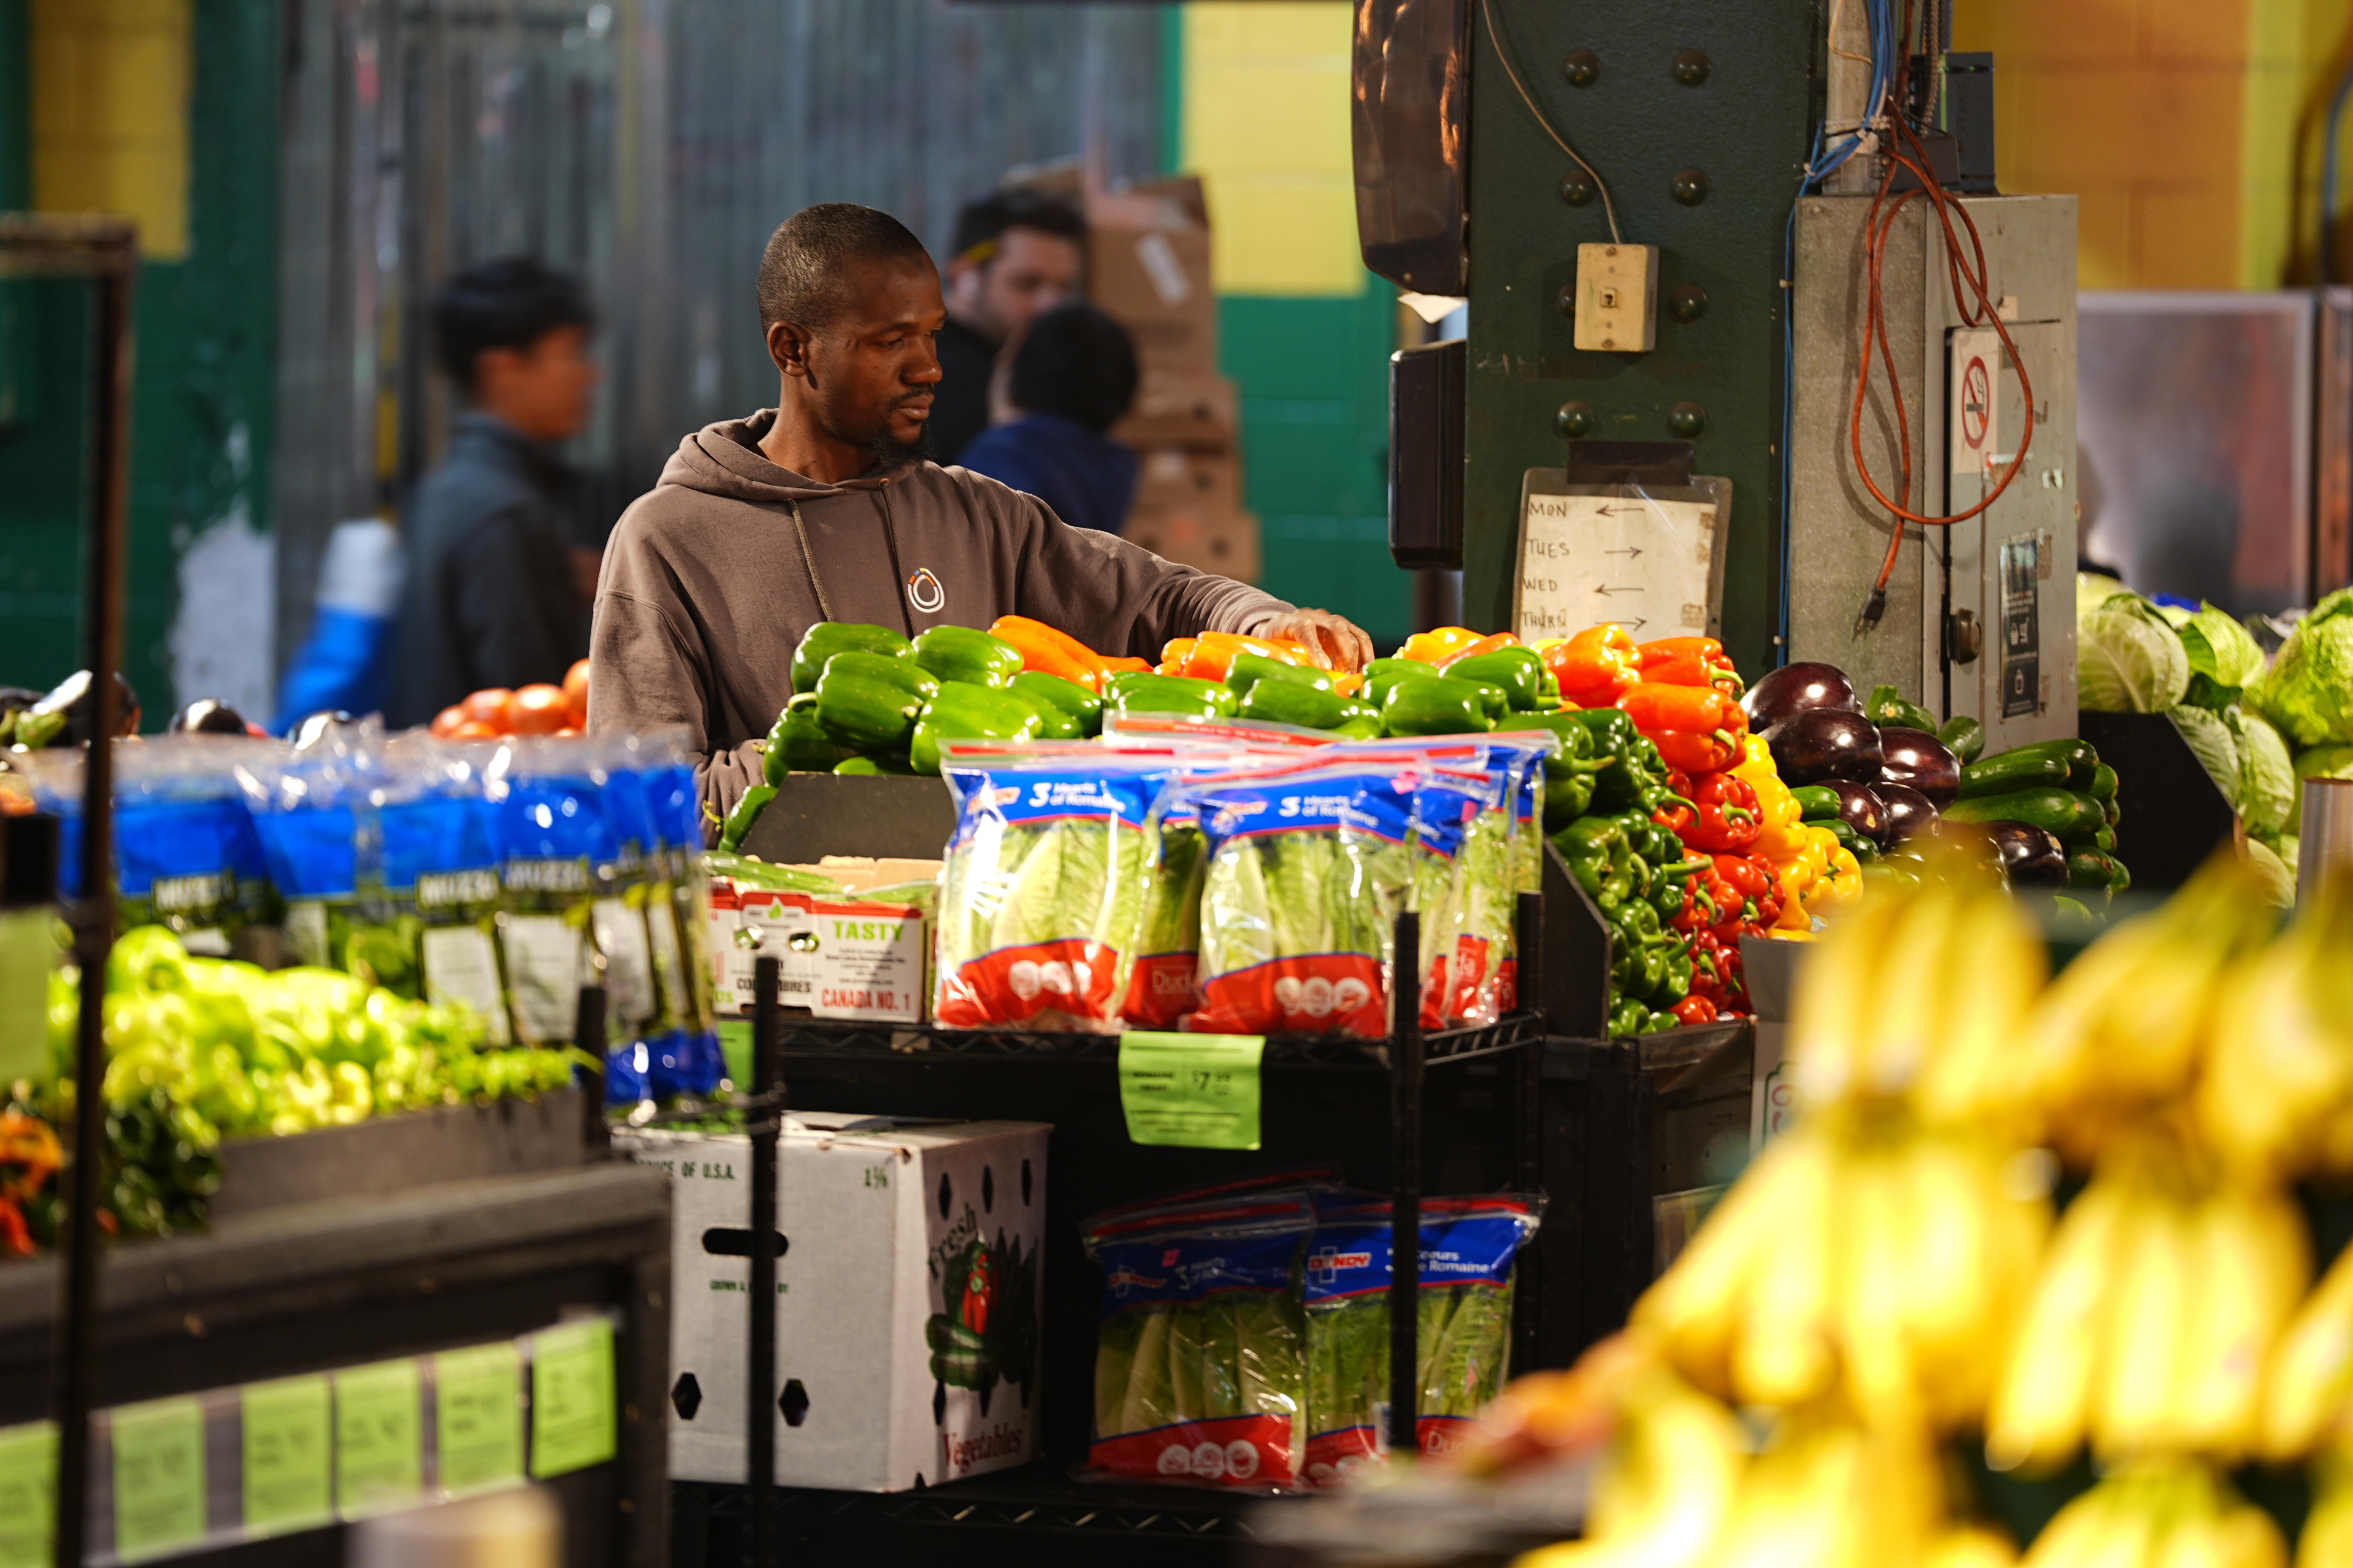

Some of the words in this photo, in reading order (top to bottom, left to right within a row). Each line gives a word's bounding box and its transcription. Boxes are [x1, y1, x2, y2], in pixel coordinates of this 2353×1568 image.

[1528, 501, 1567, 517] MON
[1526, 538, 1570, 559] TUES
[1523, 578, 1558, 592] WED
[1522, 611, 1565, 629] THURS
[1028, 782, 1052, 808] 3
[1278, 796, 1301, 817] 3
[1303, 795, 1351, 807] Hearts
[1302, 805, 1319, 817] of
[832, 921, 903, 941] TASTY
[822, 987, 872, 1008] CANADA
[903, 992, 910, 1011] 1
[682, 1161, 695, 1178] OF
[928, 1202, 978, 1279] Fresh
[1417, 1250, 1460, 1261] oeurs
[1430, 1259, 1490, 1273] Romaine
[943, 1421, 1022, 1473] Vegetables
